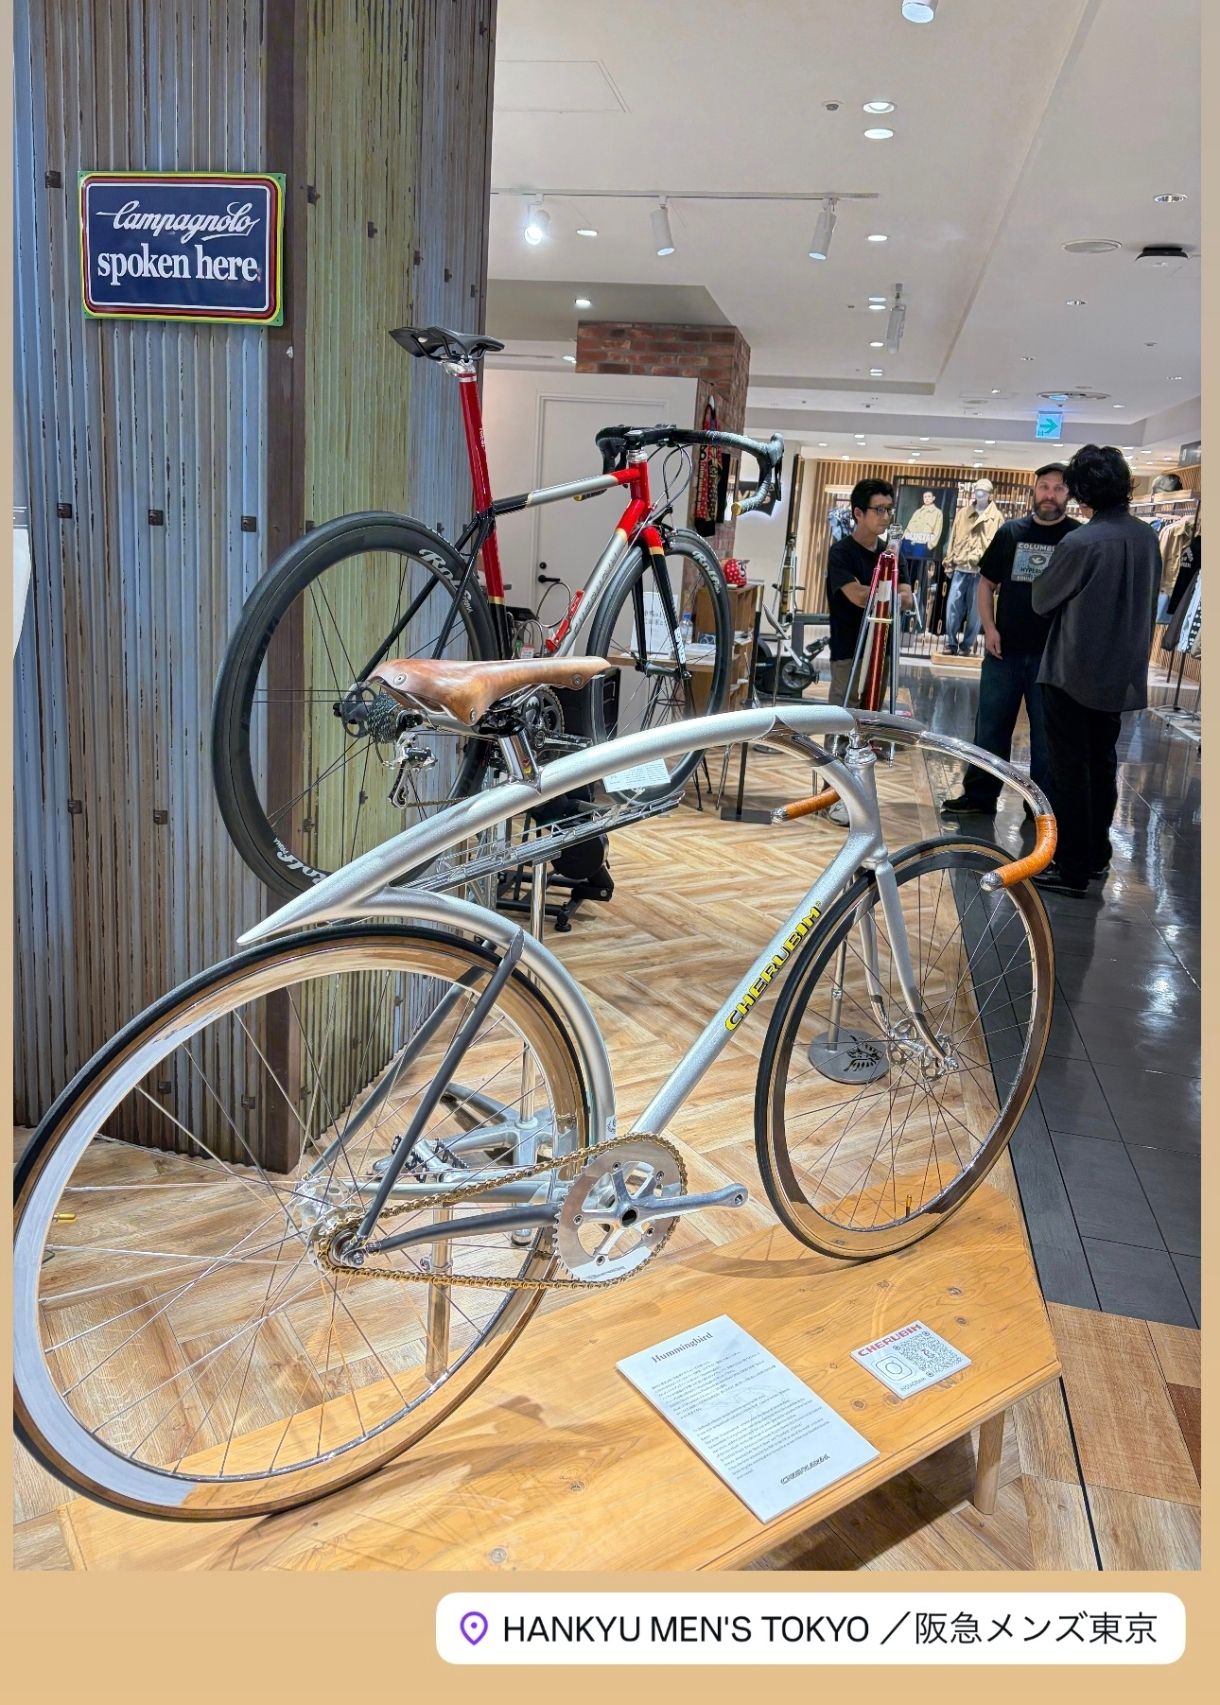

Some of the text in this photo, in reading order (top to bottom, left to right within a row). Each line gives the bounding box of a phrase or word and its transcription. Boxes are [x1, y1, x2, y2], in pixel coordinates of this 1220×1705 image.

[96, 200, 261, 244] Campagnolo
[97, 243, 258, 286] spoken here
[724, 906, 822, 1031] CHERUBIM
[651, 1332, 714, 1363] Hummingbird
[858, 1324, 922, 1357] CHERUBIM
